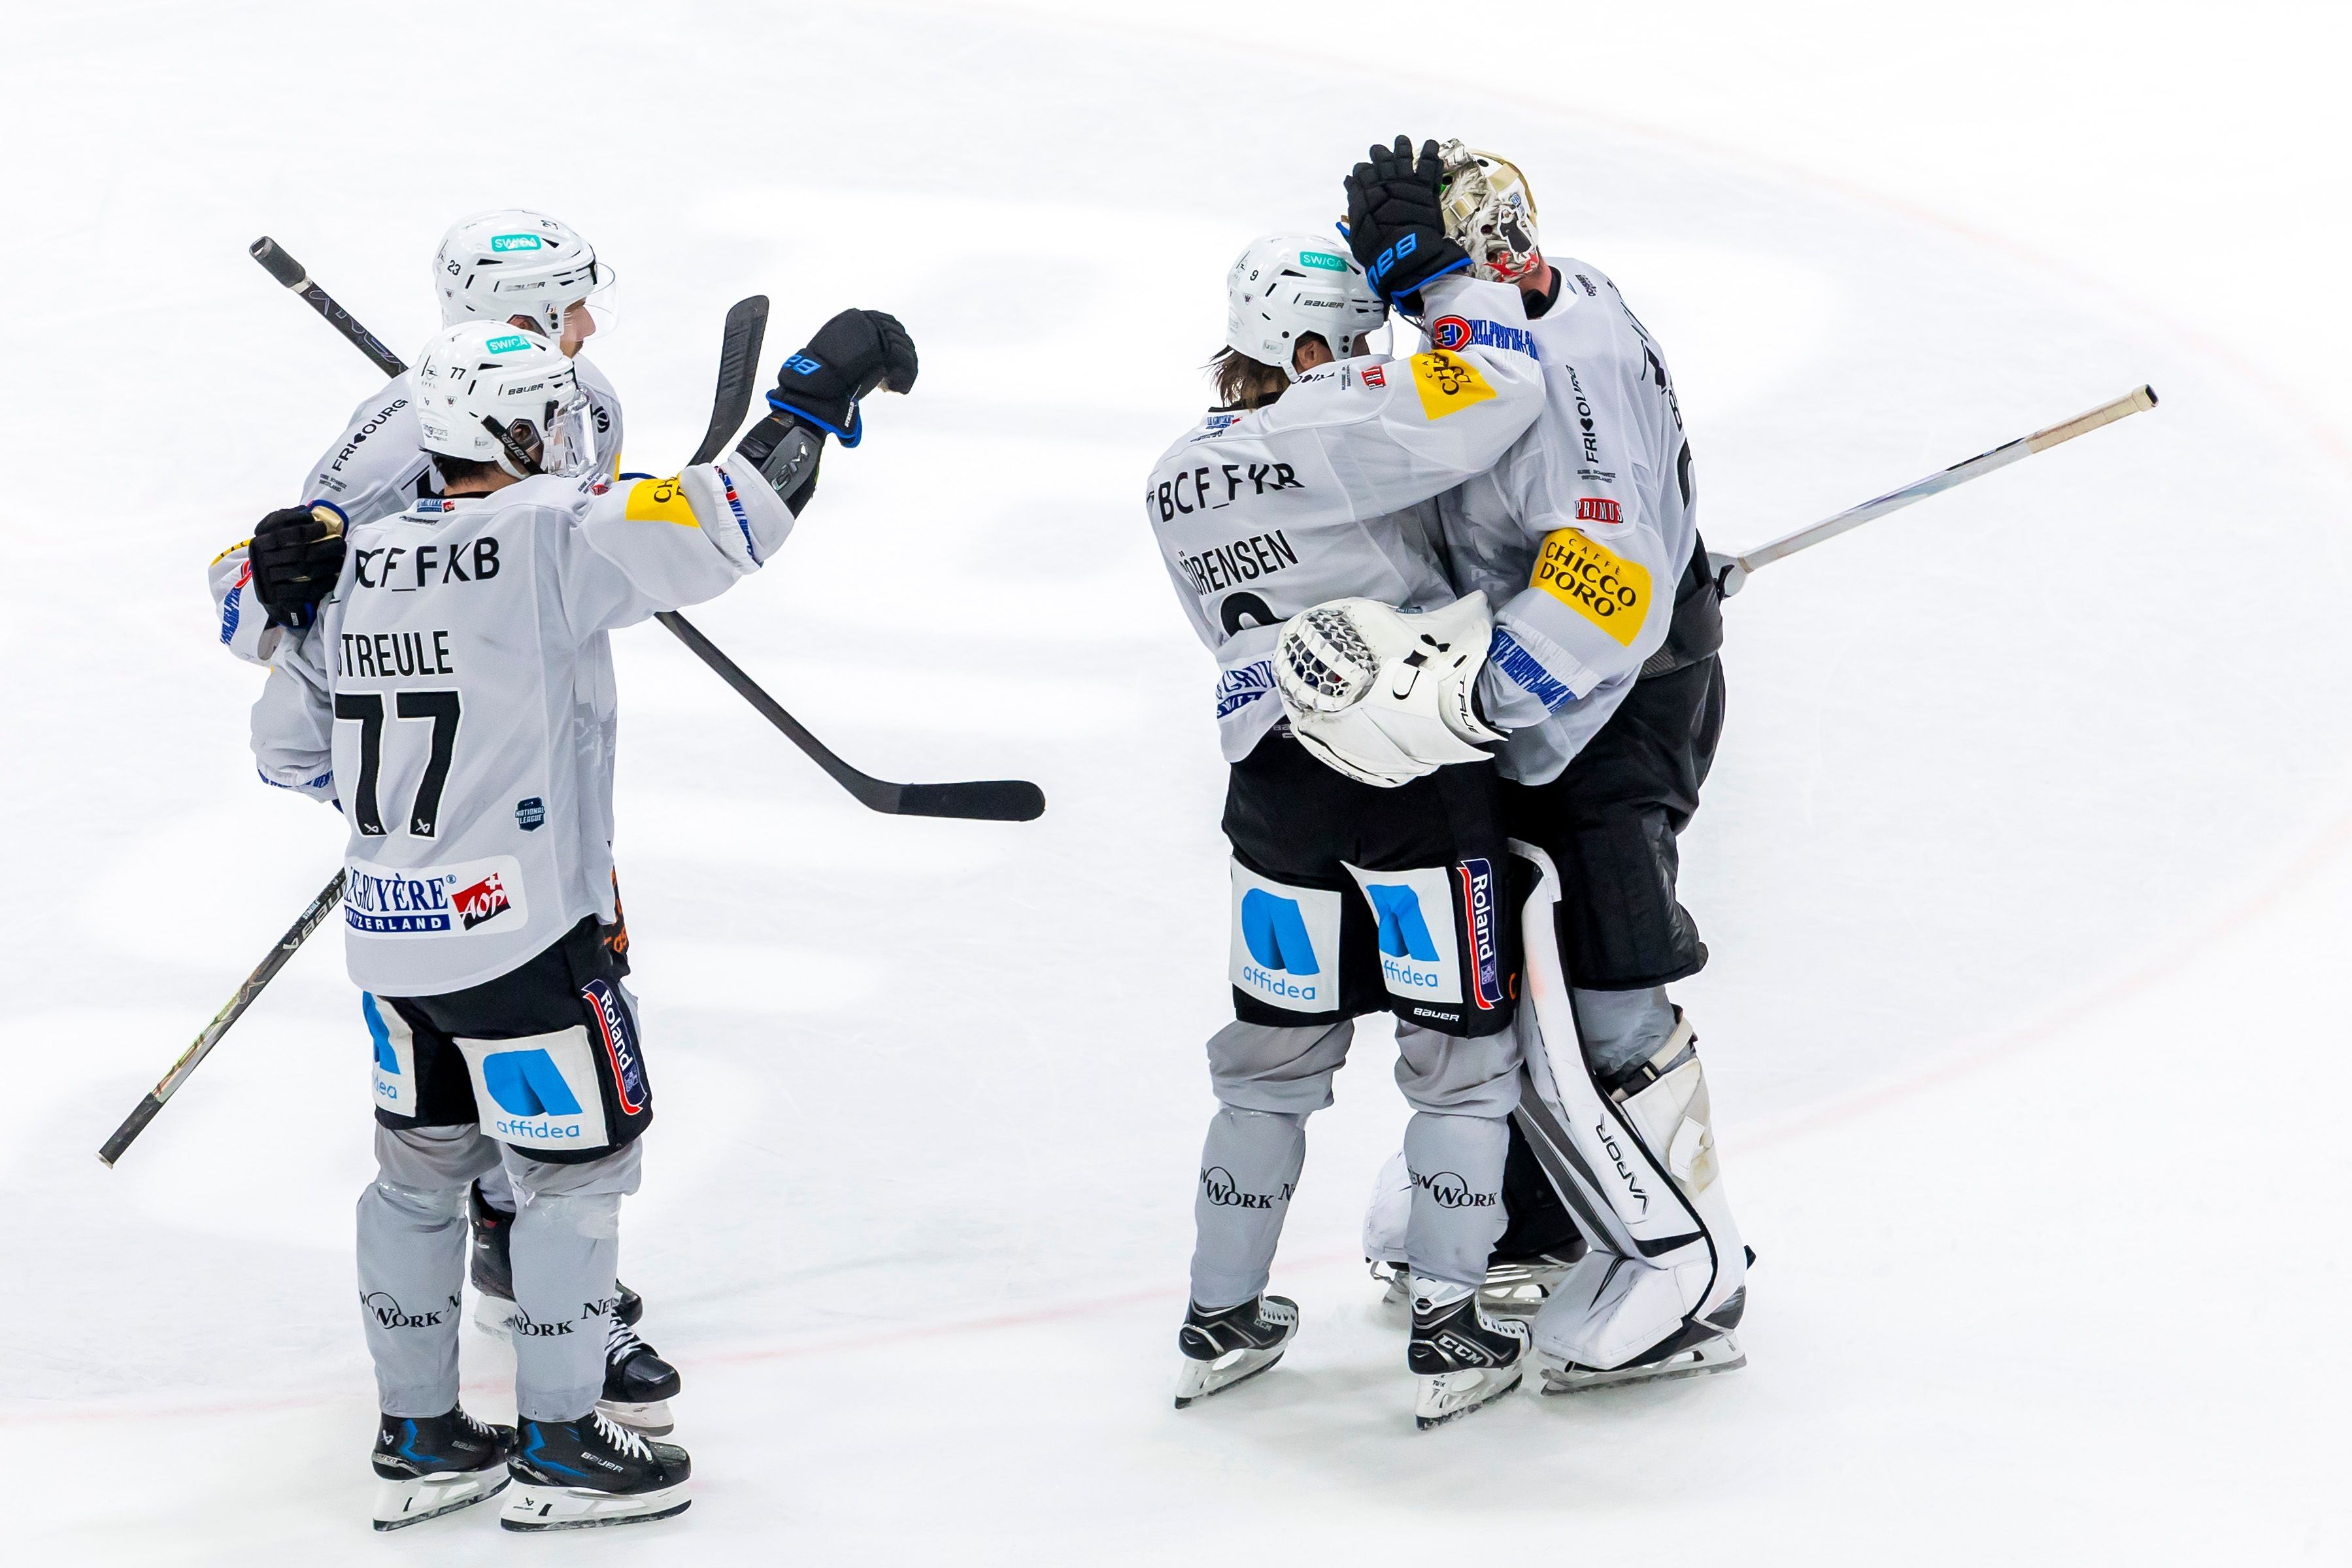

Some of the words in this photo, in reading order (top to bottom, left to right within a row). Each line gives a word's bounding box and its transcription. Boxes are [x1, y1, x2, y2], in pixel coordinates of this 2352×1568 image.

[447, 259, 461, 276] 23
[1303, 254, 1343, 268] SWICA
[1249, 270, 1259, 281] 9
[1303, 299, 1345, 309] BAUER
[490, 336, 528, 352] SWICA
[450, 367, 467, 380] 77
[507, 383, 545, 395] BAUER
[1574, 499, 1624, 524] PRIMUS
[1179, 529, 1300, 596] ÖRENSEN
[1568, 538, 1621, 575] CAFFÈ
[1545, 541, 1638, 607] CHICCO
[1539, 561, 1615, 618] D'ORO
[1223, 660, 1276, 692] GRUY
[335, 690, 462, 838] 77
[516, 807, 545, 817] NATIONAL
[519, 814, 543, 824] LEAGUE
[460, 889, 507, 922] AOP
[1472, 873, 1494, 961] Roland
[1243, 965, 1316, 1001] affidea
[1383, 959, 1438, 988] ffidea
[1413, 1007, 1460, 1022] BAUER
[600, 988, 633, 1072] Roland
[496, 1118, 580, 1139] affidea
[1437, 1334, 1484, 1365] CCM
[580, 1451, 625, 1474] BAUER
